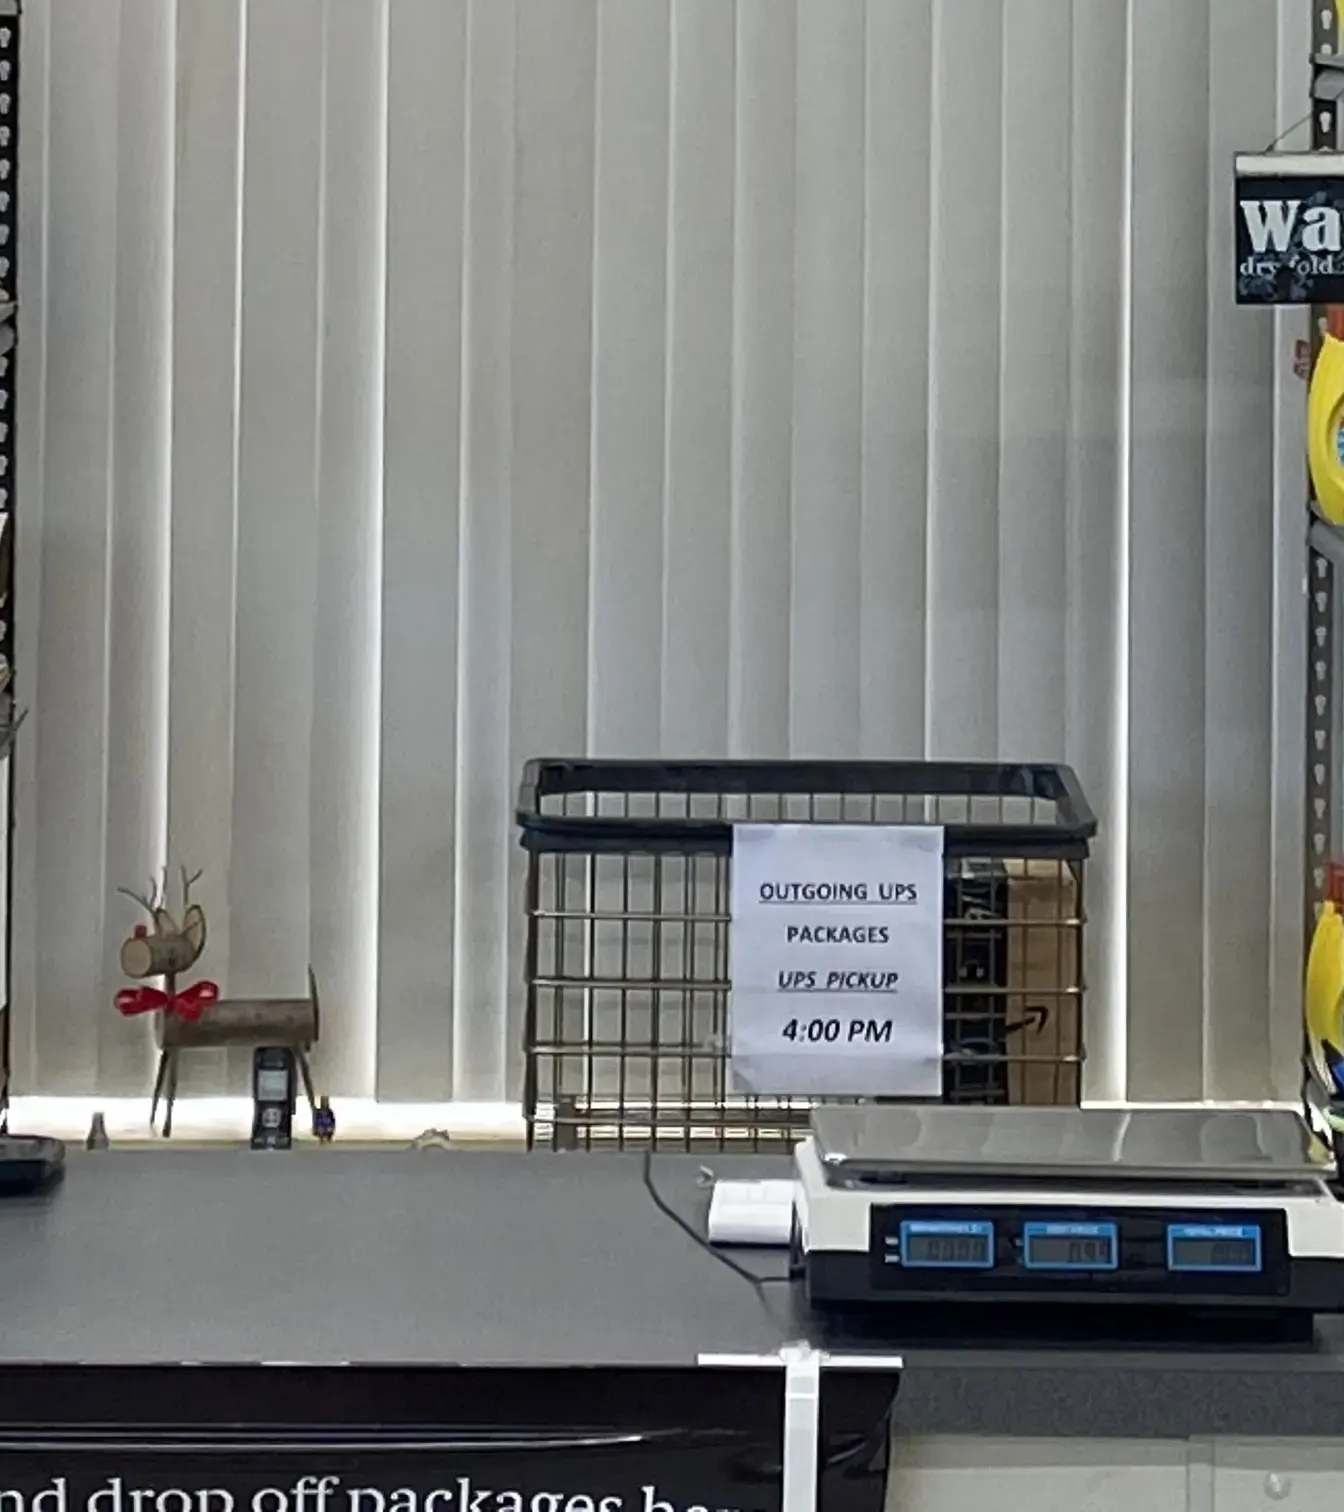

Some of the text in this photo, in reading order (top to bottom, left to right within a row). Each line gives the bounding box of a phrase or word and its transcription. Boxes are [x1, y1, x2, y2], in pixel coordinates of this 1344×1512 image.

[759, 882, 918, 902] OUTGOING UPS
[786, 925, 890, 945] PACKAGES
[777, 970, 899, 990] UPS PICKUP
[781, 1018, 895, 1043] 4:00 PM
